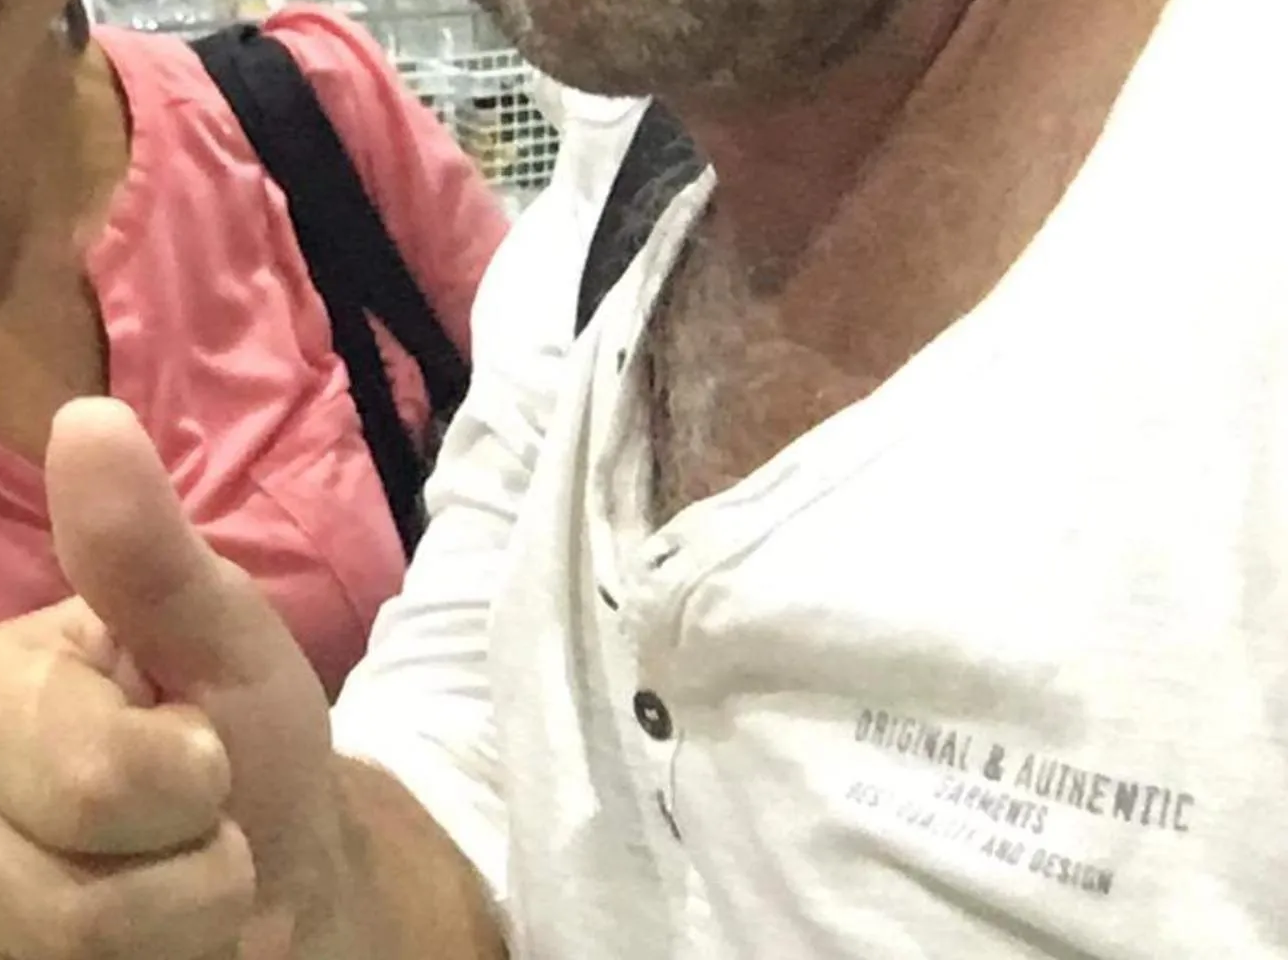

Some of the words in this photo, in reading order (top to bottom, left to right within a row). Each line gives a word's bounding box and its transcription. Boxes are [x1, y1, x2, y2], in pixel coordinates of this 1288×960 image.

[854, 708, 973, 772] ORIGINAL
[983, 743, 1006, 782] &
[1013, 752, 1196, 832] AUTHENTIC
[844, 781, 894, 809] BES
[980, 835, 1026, 867] AND
[1028, 848, 1115, 896] DESIGN
